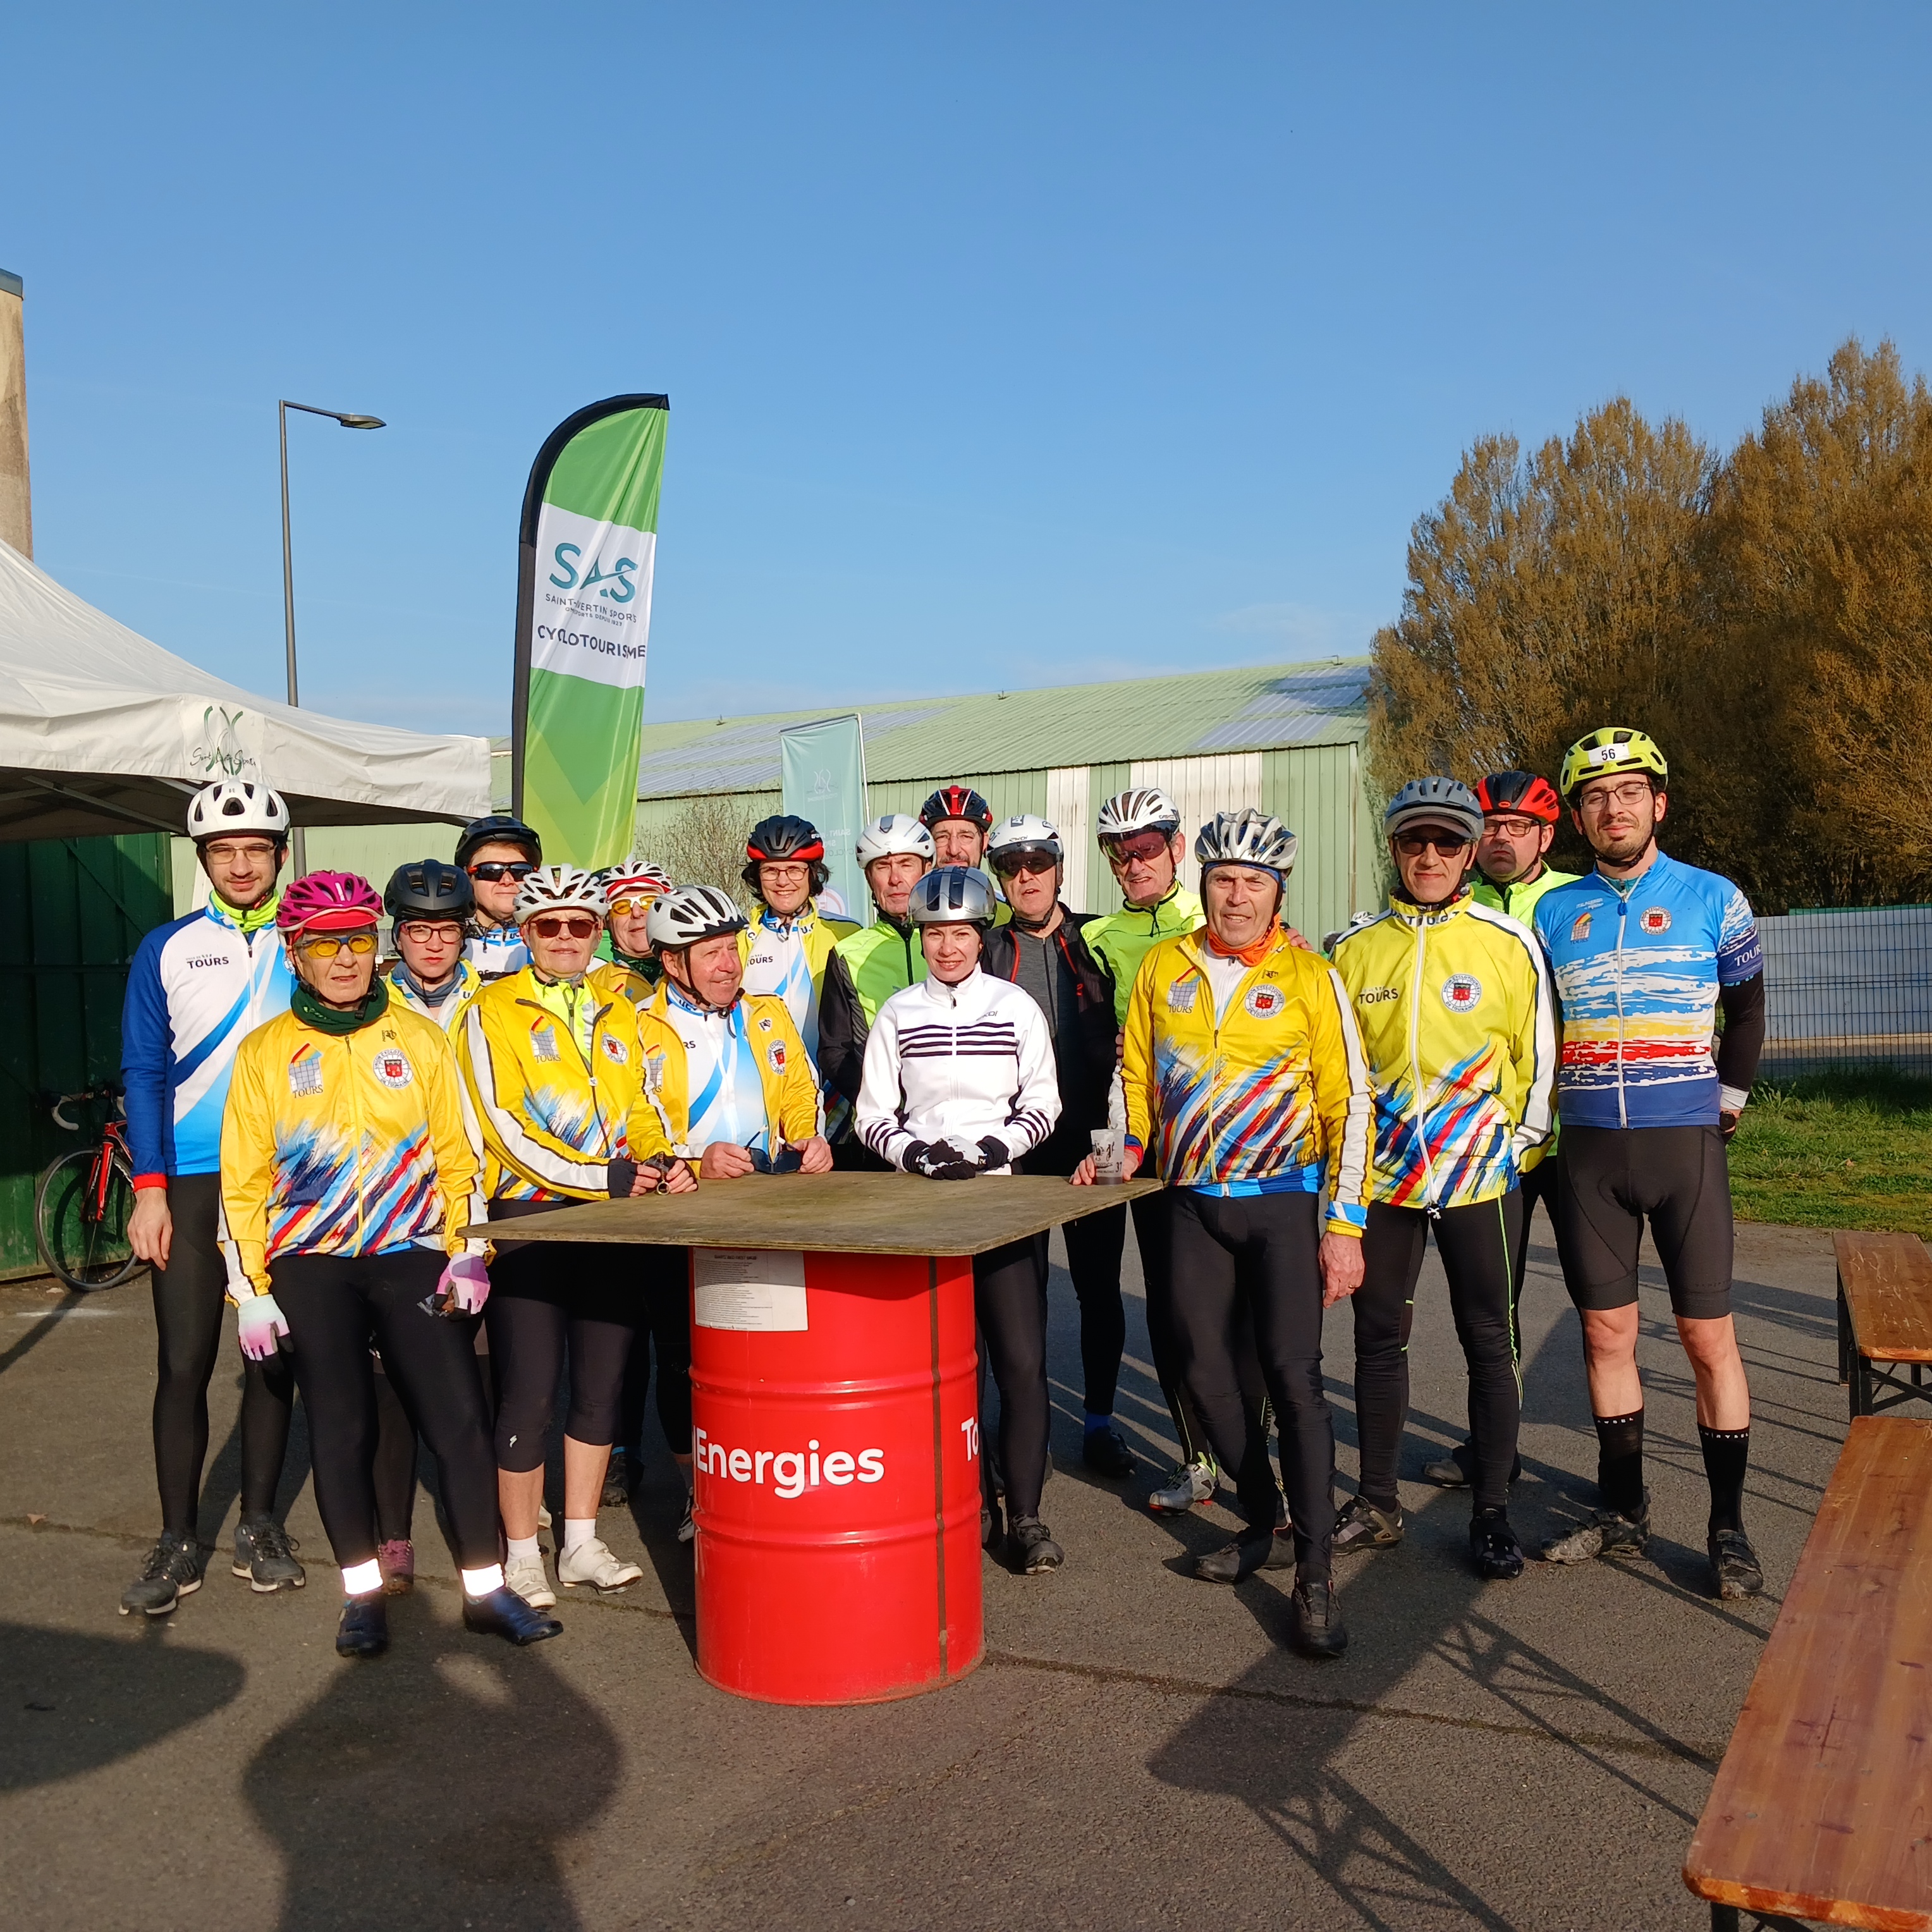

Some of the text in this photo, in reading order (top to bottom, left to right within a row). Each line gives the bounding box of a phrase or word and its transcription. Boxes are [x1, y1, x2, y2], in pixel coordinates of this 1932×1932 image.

[549, 542, 639, 604] SAS
[546, 593, 637, 623] SAINT-VERTIN SPORS
[537, 625, 646, 659] CYCLOTOURISME
[1601, 749, 1616, 761] 56
[186, 957, 229, 969] TOURS
[1734, 944, 1761, 967] TOUR
[1358, 987, 1398, 1005] TOURS
[1168, 1005, 1193, 1014] TOURS
[534, 1055, 561, 1063] TOURS
[292, 1084, 324, 1099] TOURS
